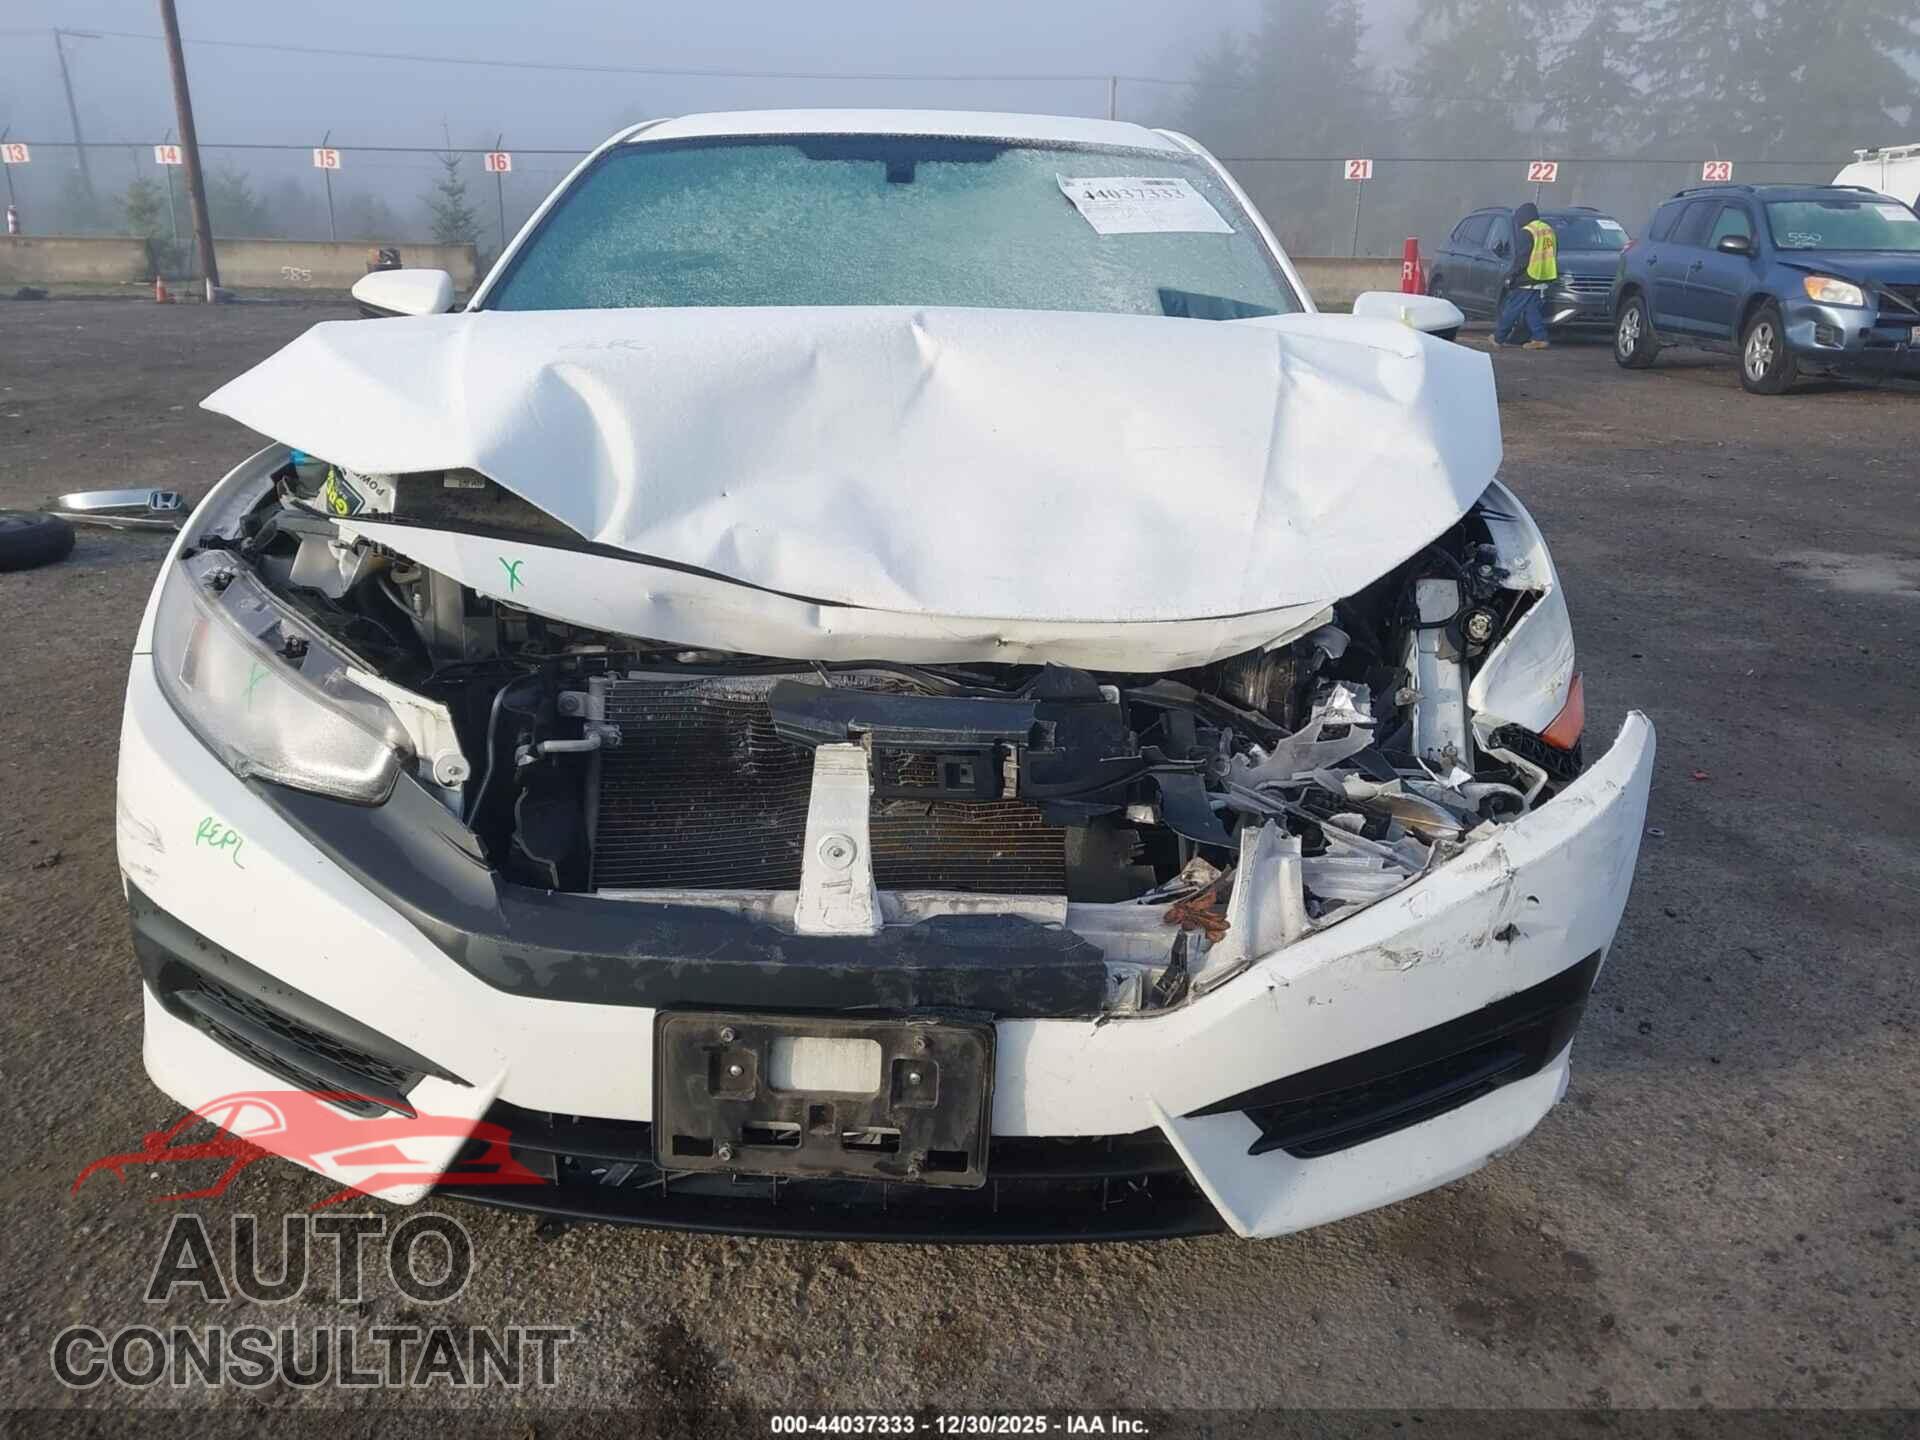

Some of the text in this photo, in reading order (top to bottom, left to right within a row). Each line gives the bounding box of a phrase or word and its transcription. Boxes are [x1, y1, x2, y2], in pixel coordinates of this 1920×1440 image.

[7, 144, 25, 162] 13
[159, 146, 177, 163] 14
[317, 149, 336, 168] 15
[488, 153, 507, 172] 16
[1349, 160, 1368, 178] 21
[1531, 162, 1556, 180] 22
[1705, 162, 1730, 180] 23
